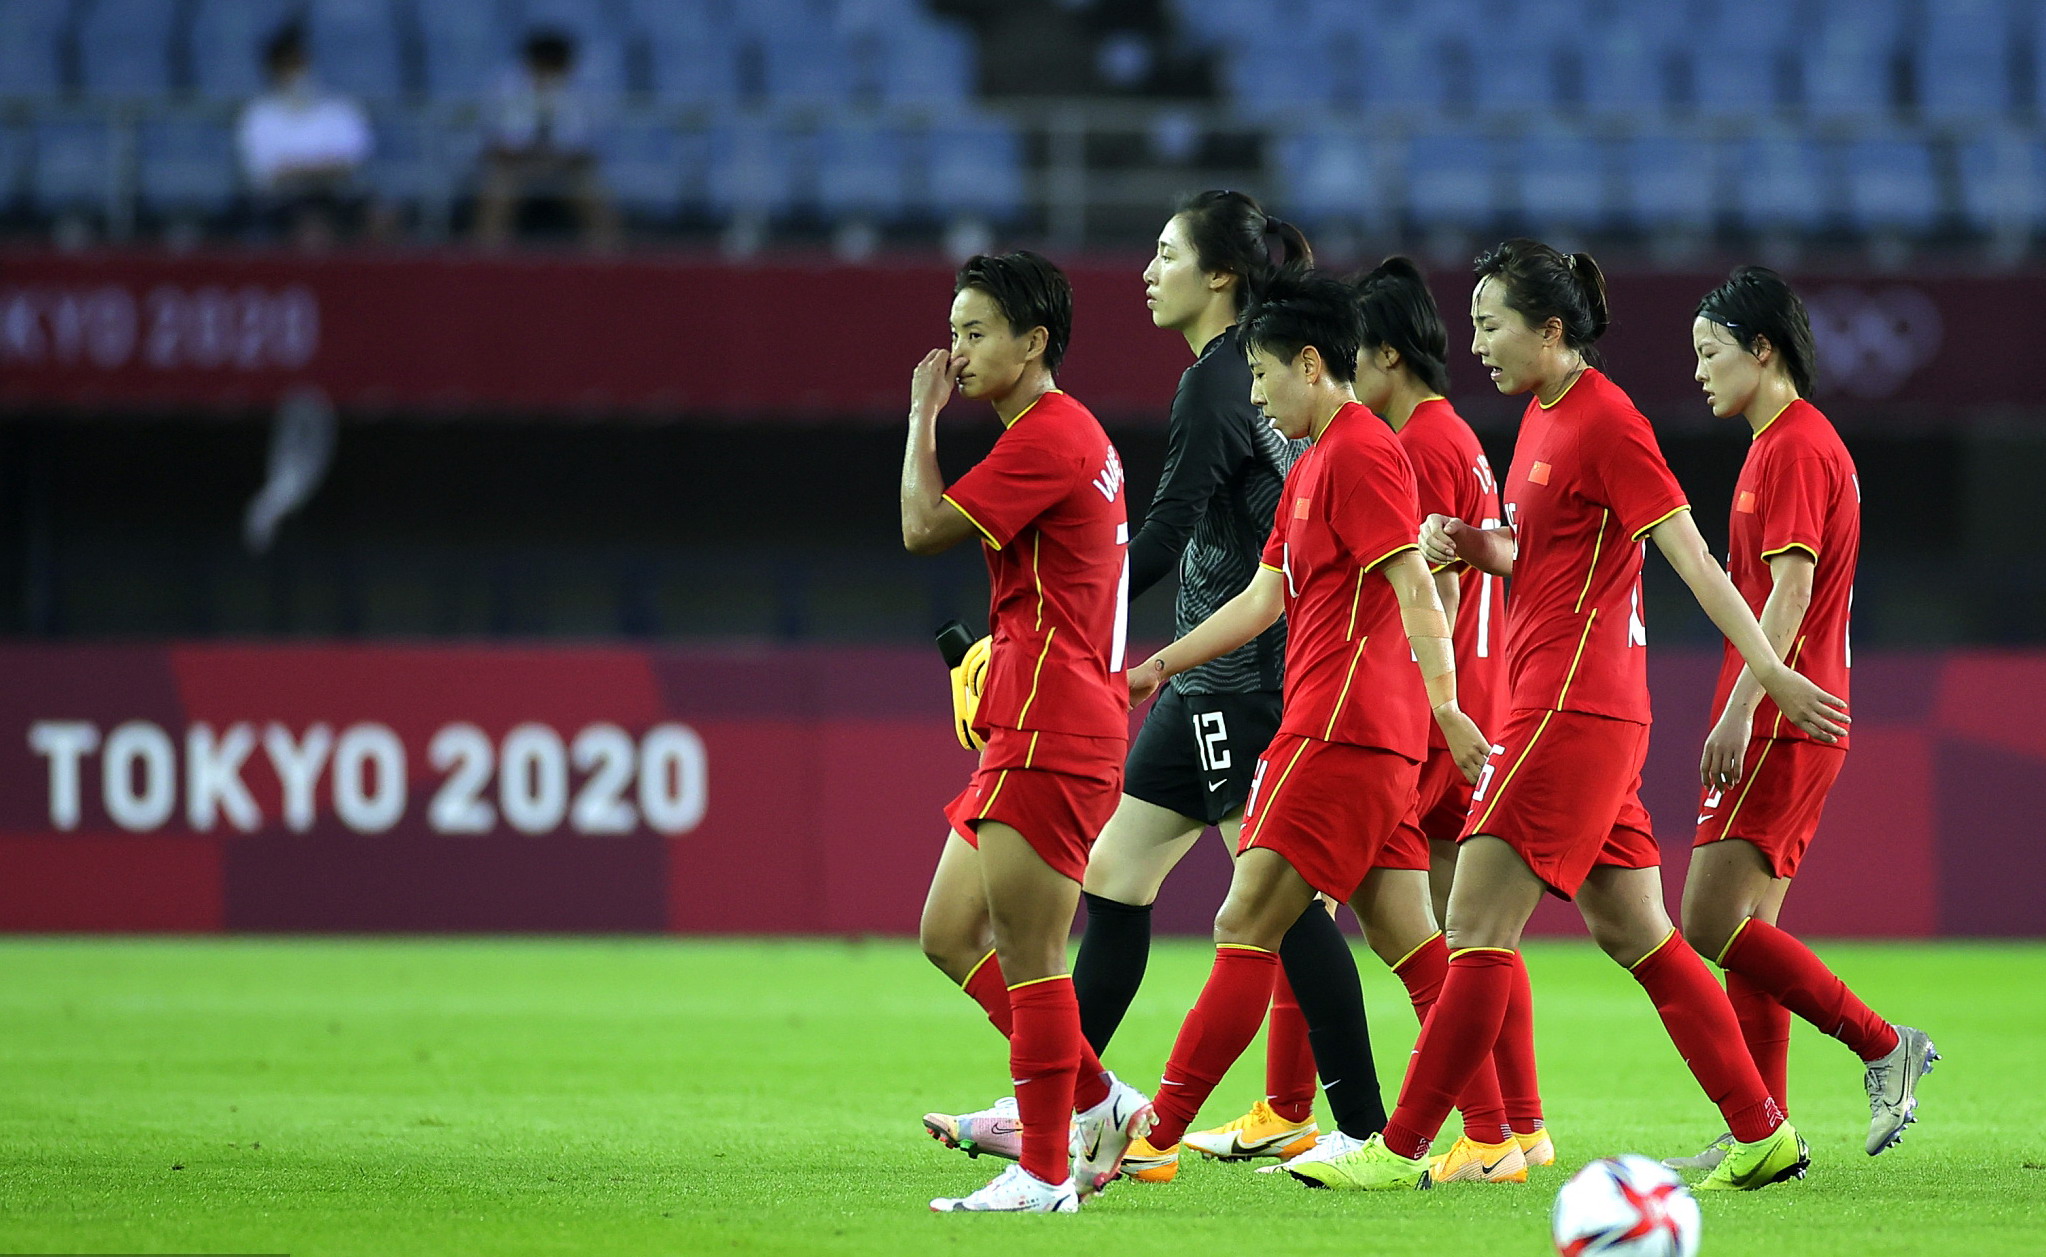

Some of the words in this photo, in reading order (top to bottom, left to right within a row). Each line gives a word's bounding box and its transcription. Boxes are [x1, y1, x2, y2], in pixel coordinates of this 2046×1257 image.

[149, 285, 318, 367] 2020
[28, 721, 408, 834] TOKYO
[428, 722, 709, 834] 2020
[1192, 711, 1232, 771] 12
